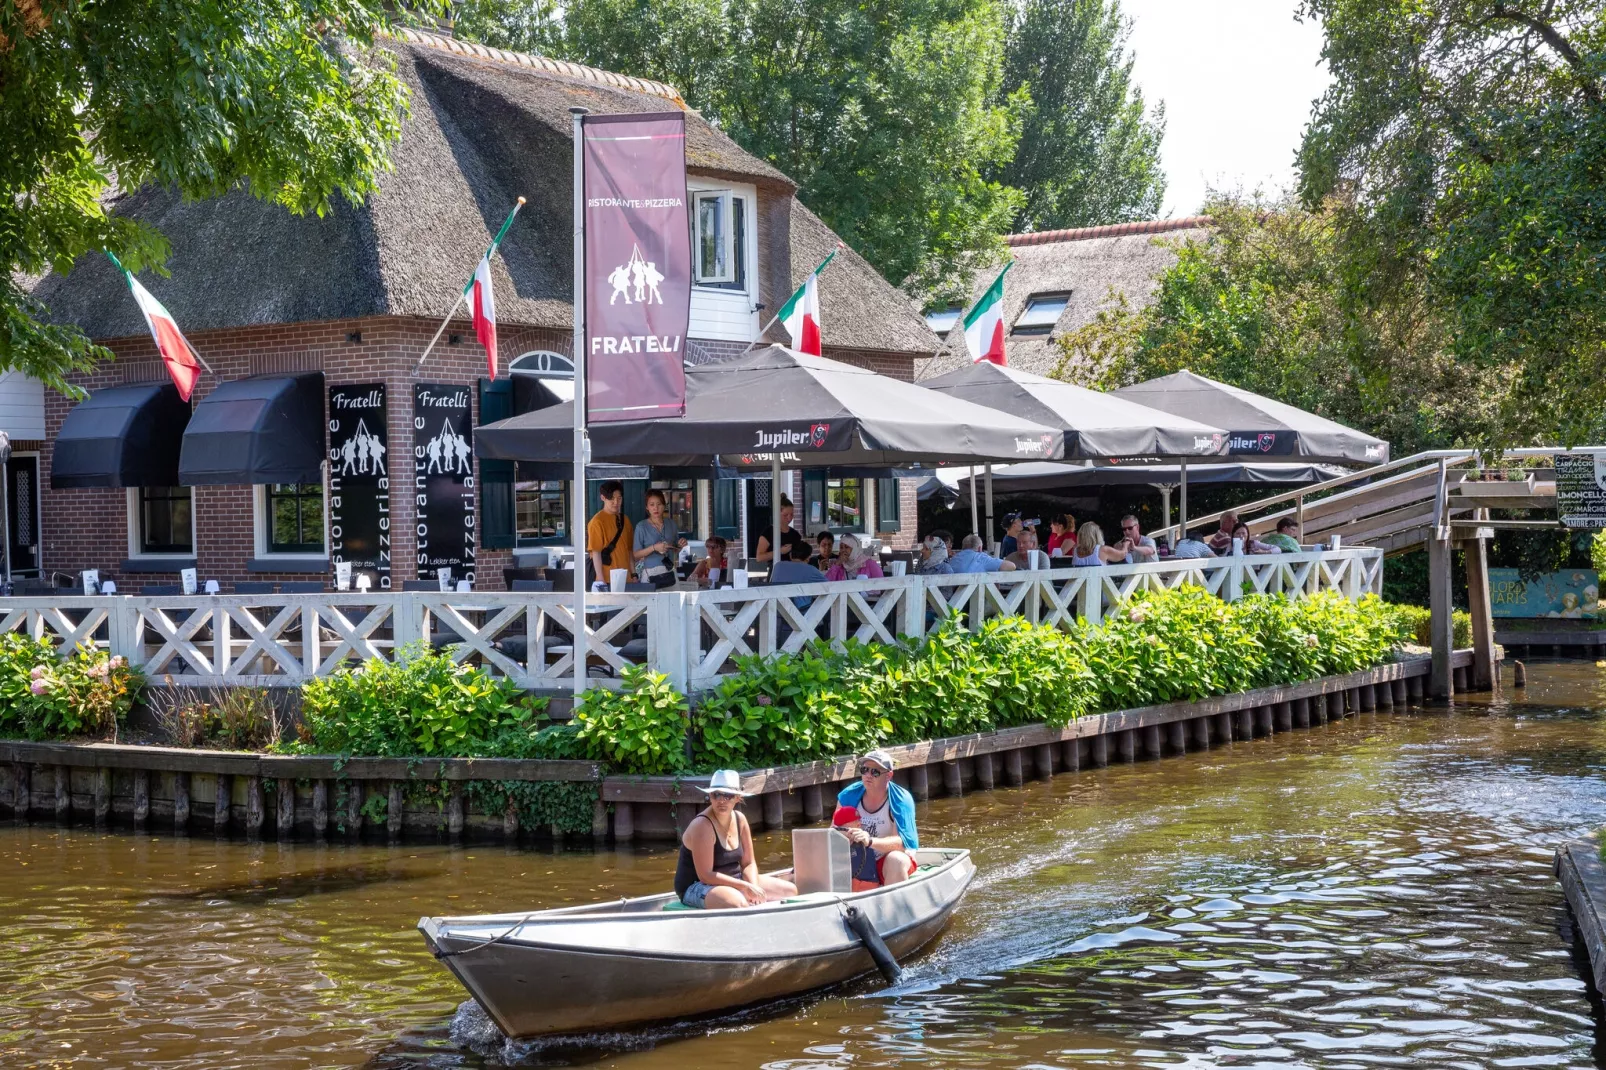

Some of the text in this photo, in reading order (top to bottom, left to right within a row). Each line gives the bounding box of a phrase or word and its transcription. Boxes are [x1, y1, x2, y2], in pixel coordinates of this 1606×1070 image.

[332, 390, 382, 409] Fratelli
[418, 391, 469, 408] Fratelli
[753, 429, 809, 449] Jupiler
[1014, 437, 1043, 455] Jupiler
[376, 476, 391, 588] pizzeria
[461, 475, 476, 584] pizzeria
